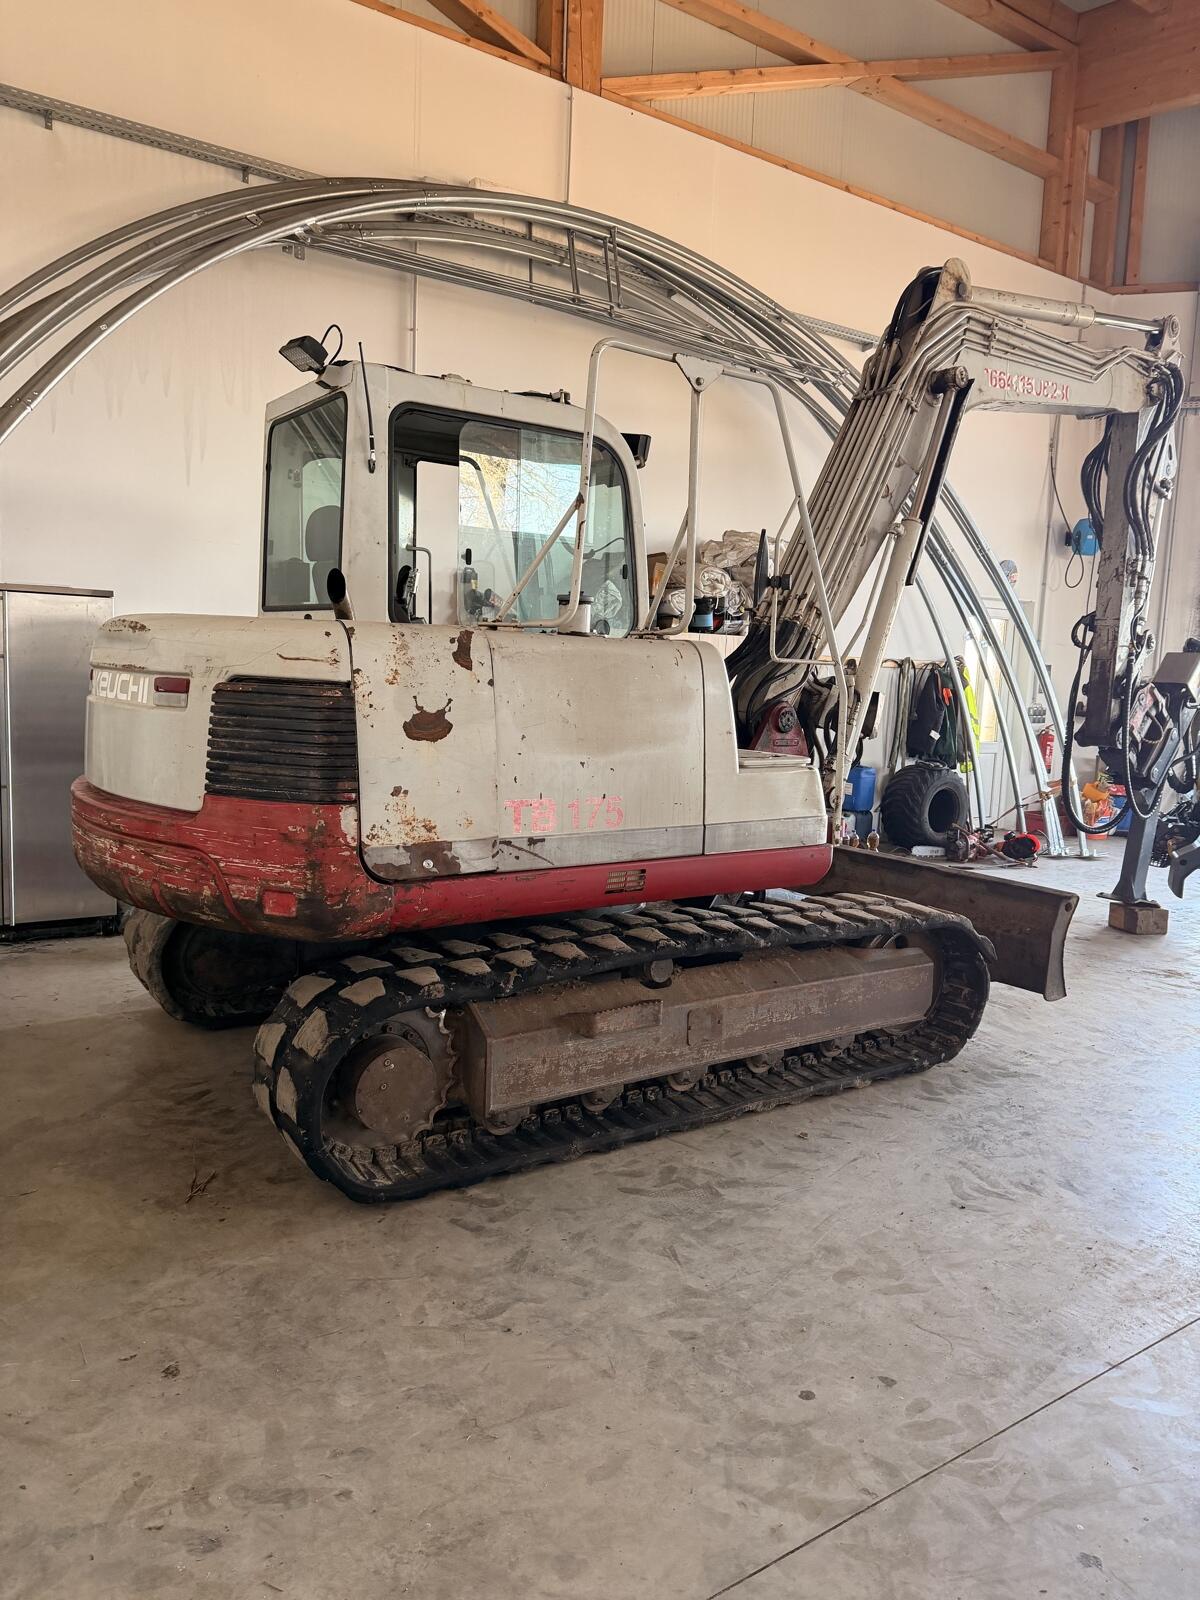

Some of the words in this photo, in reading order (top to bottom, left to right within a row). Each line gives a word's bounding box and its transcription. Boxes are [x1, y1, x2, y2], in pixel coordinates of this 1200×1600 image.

[95, 670, 149, 703] KEUCHI
[504, 799, 558, 833] TB
[568, 795, 624, 829] 175
